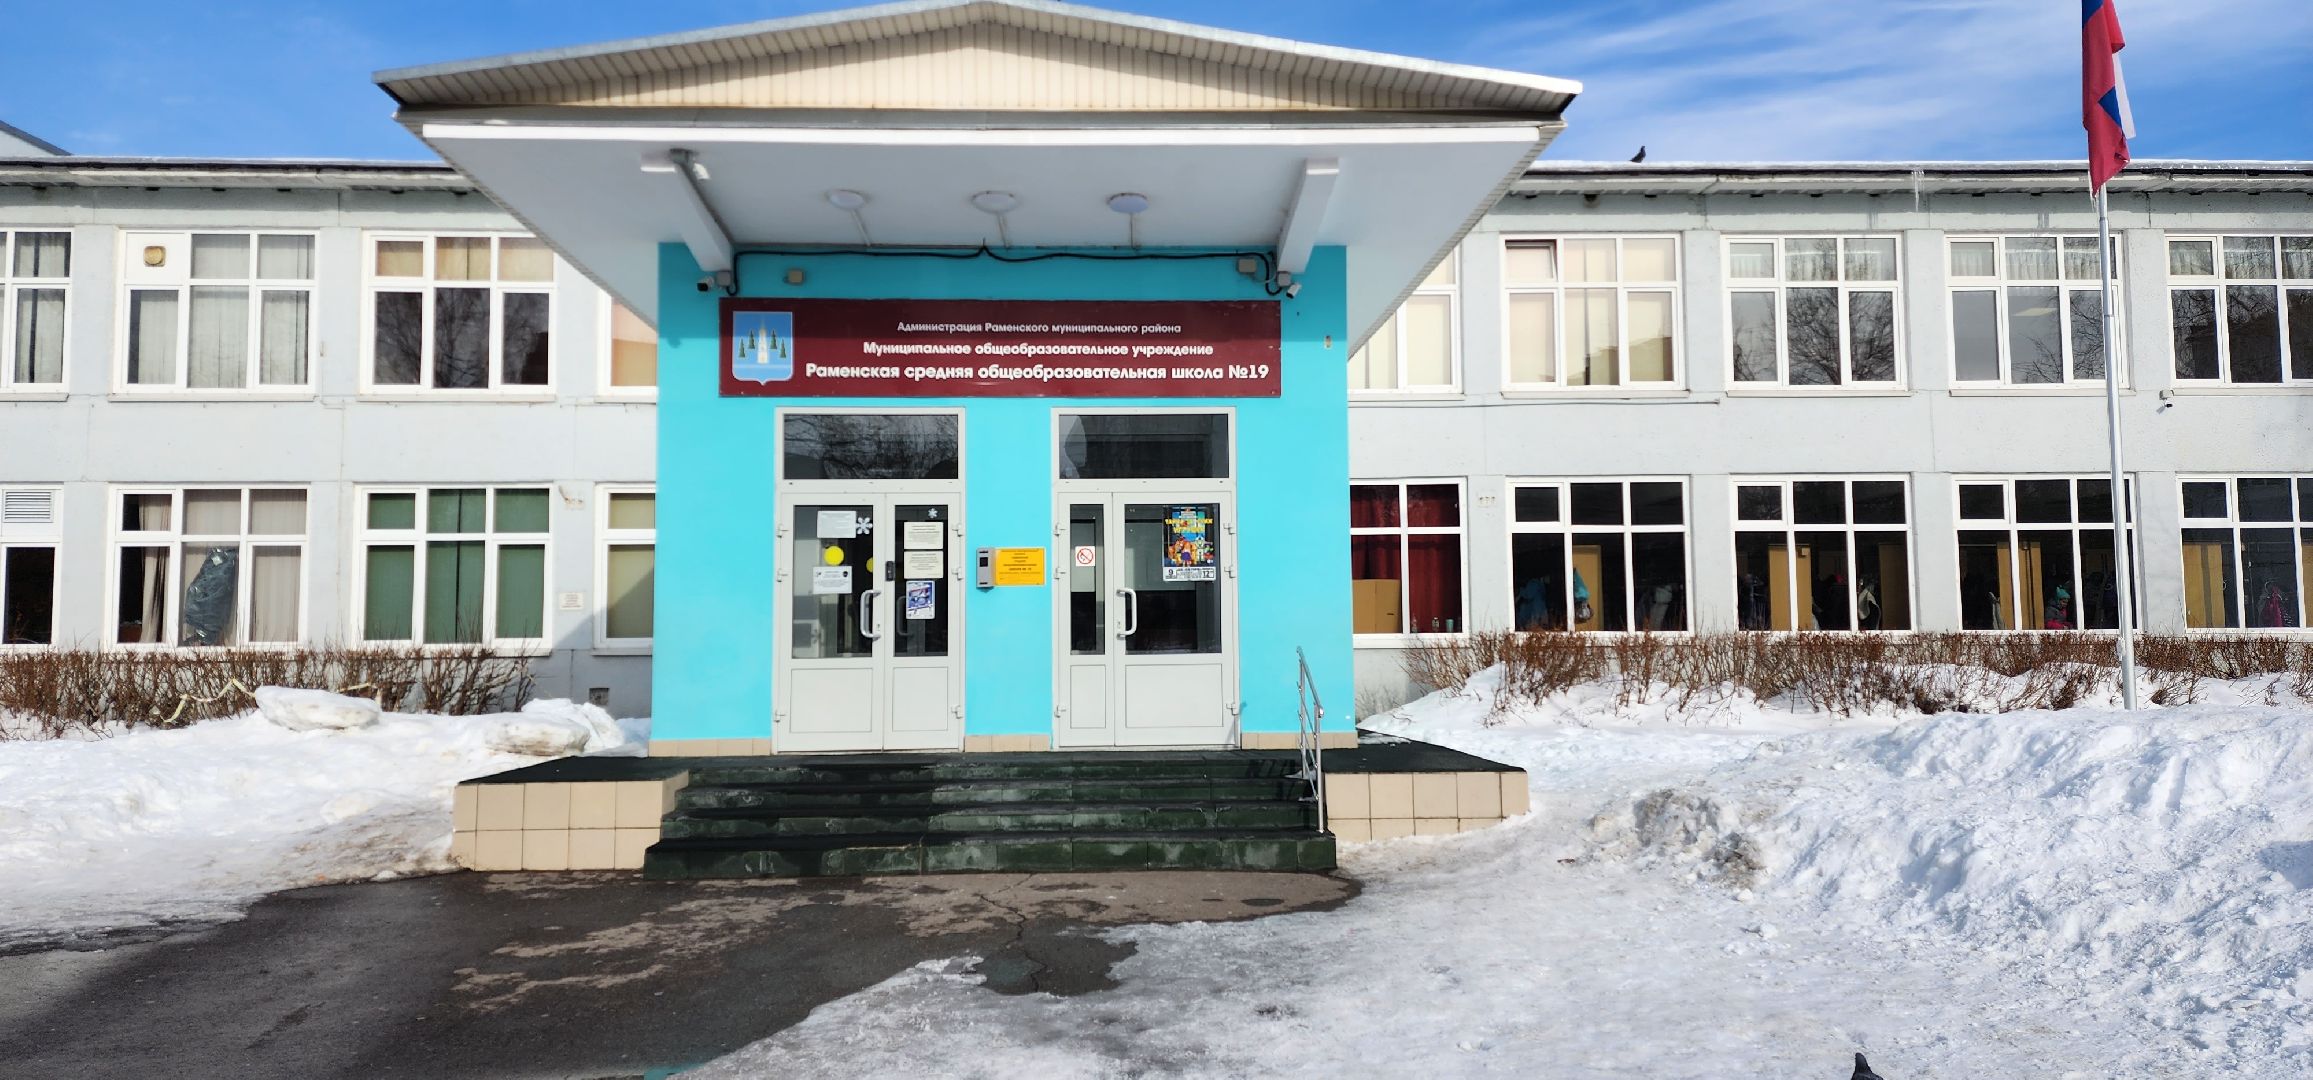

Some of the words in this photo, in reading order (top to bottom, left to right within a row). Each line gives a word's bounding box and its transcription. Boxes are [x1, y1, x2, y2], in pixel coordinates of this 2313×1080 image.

[897, 322, 982, 334] Администрация
[985, 322, 1049, 333] Раменского
[1052, 324, 1138, 334] муниципального
[1142, 323, 1181, 335] района
[863, 341, 971, 357] Муниципальное
[974, 342, 1129, 357] общеобразовательное
[1132, 345, 1213, 358] учреждение
[805, 362, 900, 378] Раменская
[904, 365, 973, 382] средняя
[977, 364, 1167, 382] общеобразовательная
[1171, 367, 1223, 379] школа
[1228, 364, 1269, 379] №19
